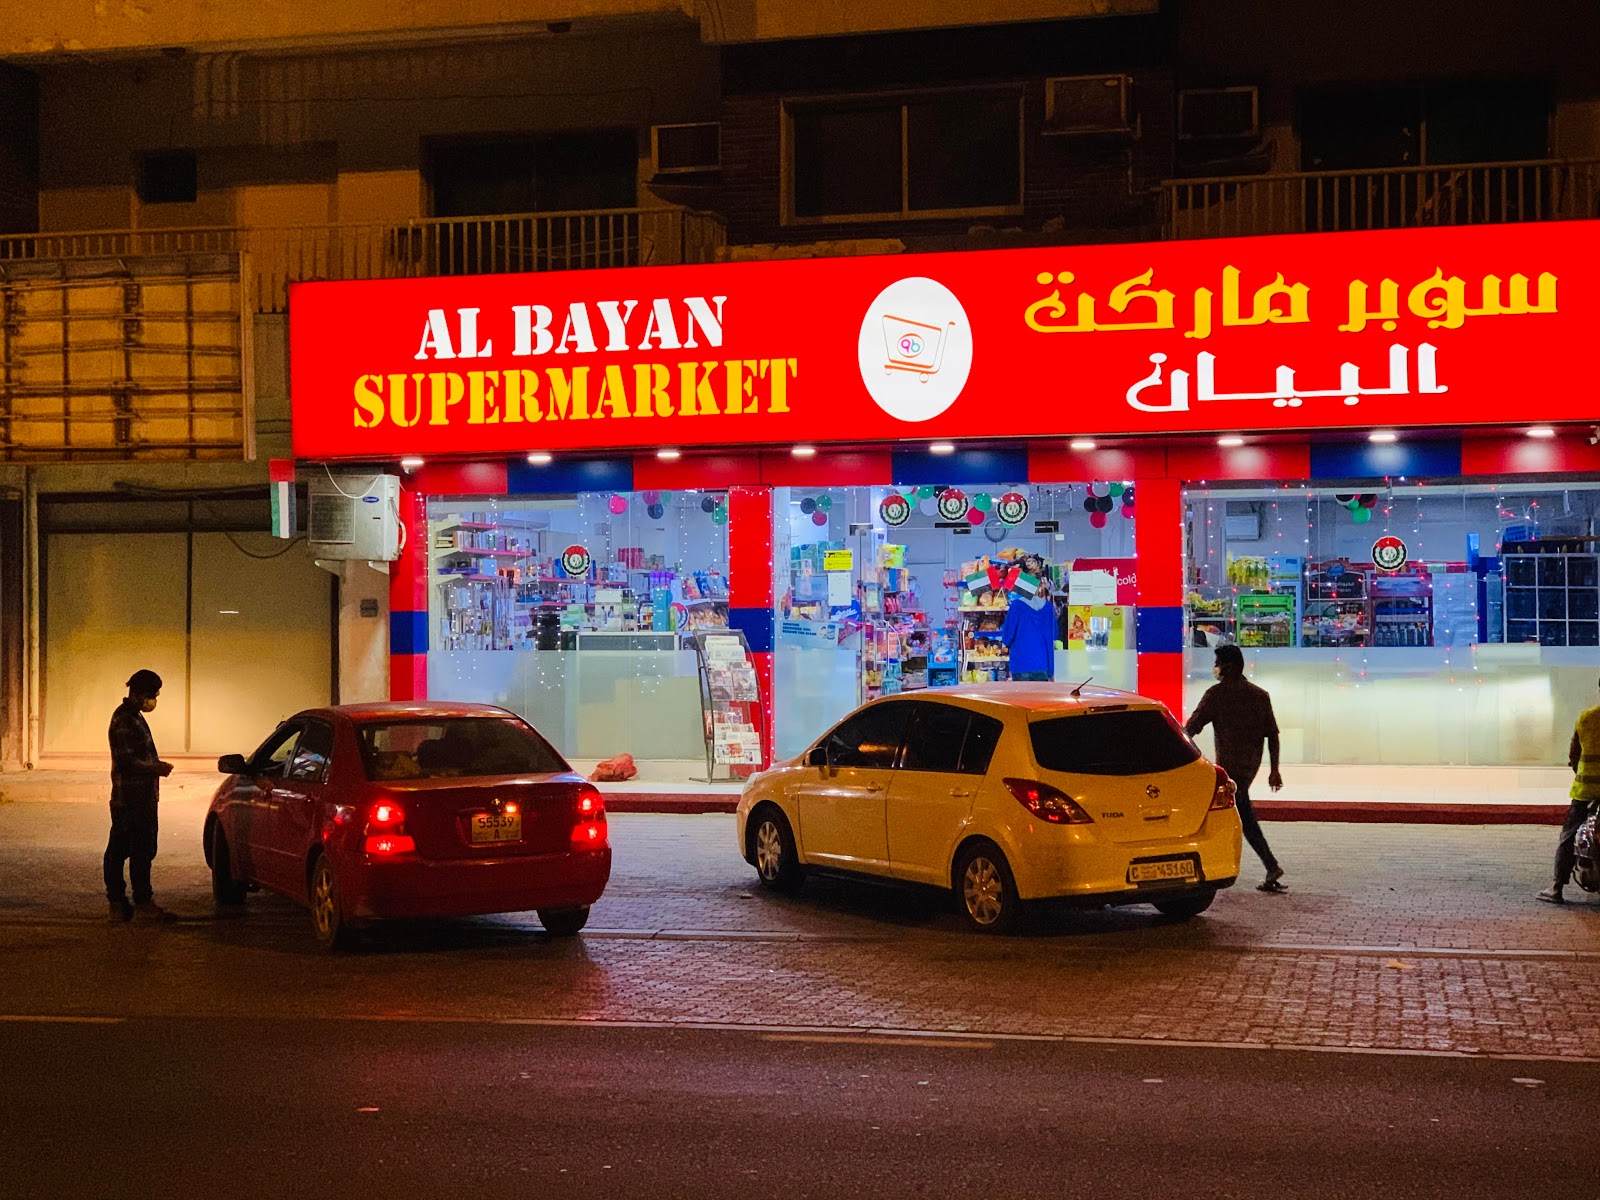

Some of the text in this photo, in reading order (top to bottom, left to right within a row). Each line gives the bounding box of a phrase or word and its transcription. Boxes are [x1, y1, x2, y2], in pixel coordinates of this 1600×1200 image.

[1024, 264, 1558, 339] سوبر ماركت
[414, 296, 727, 360] AL BAYAN
[353, 358, 798, 428] SUPERMARKET
[1126, 342, 1449, 412] البيان
[1117, 574, 1137, 586] cold
[478, 816, 513, 829] 55539
[494, 829, 501, 840] A
[1131, 867, 1139, 880] C
